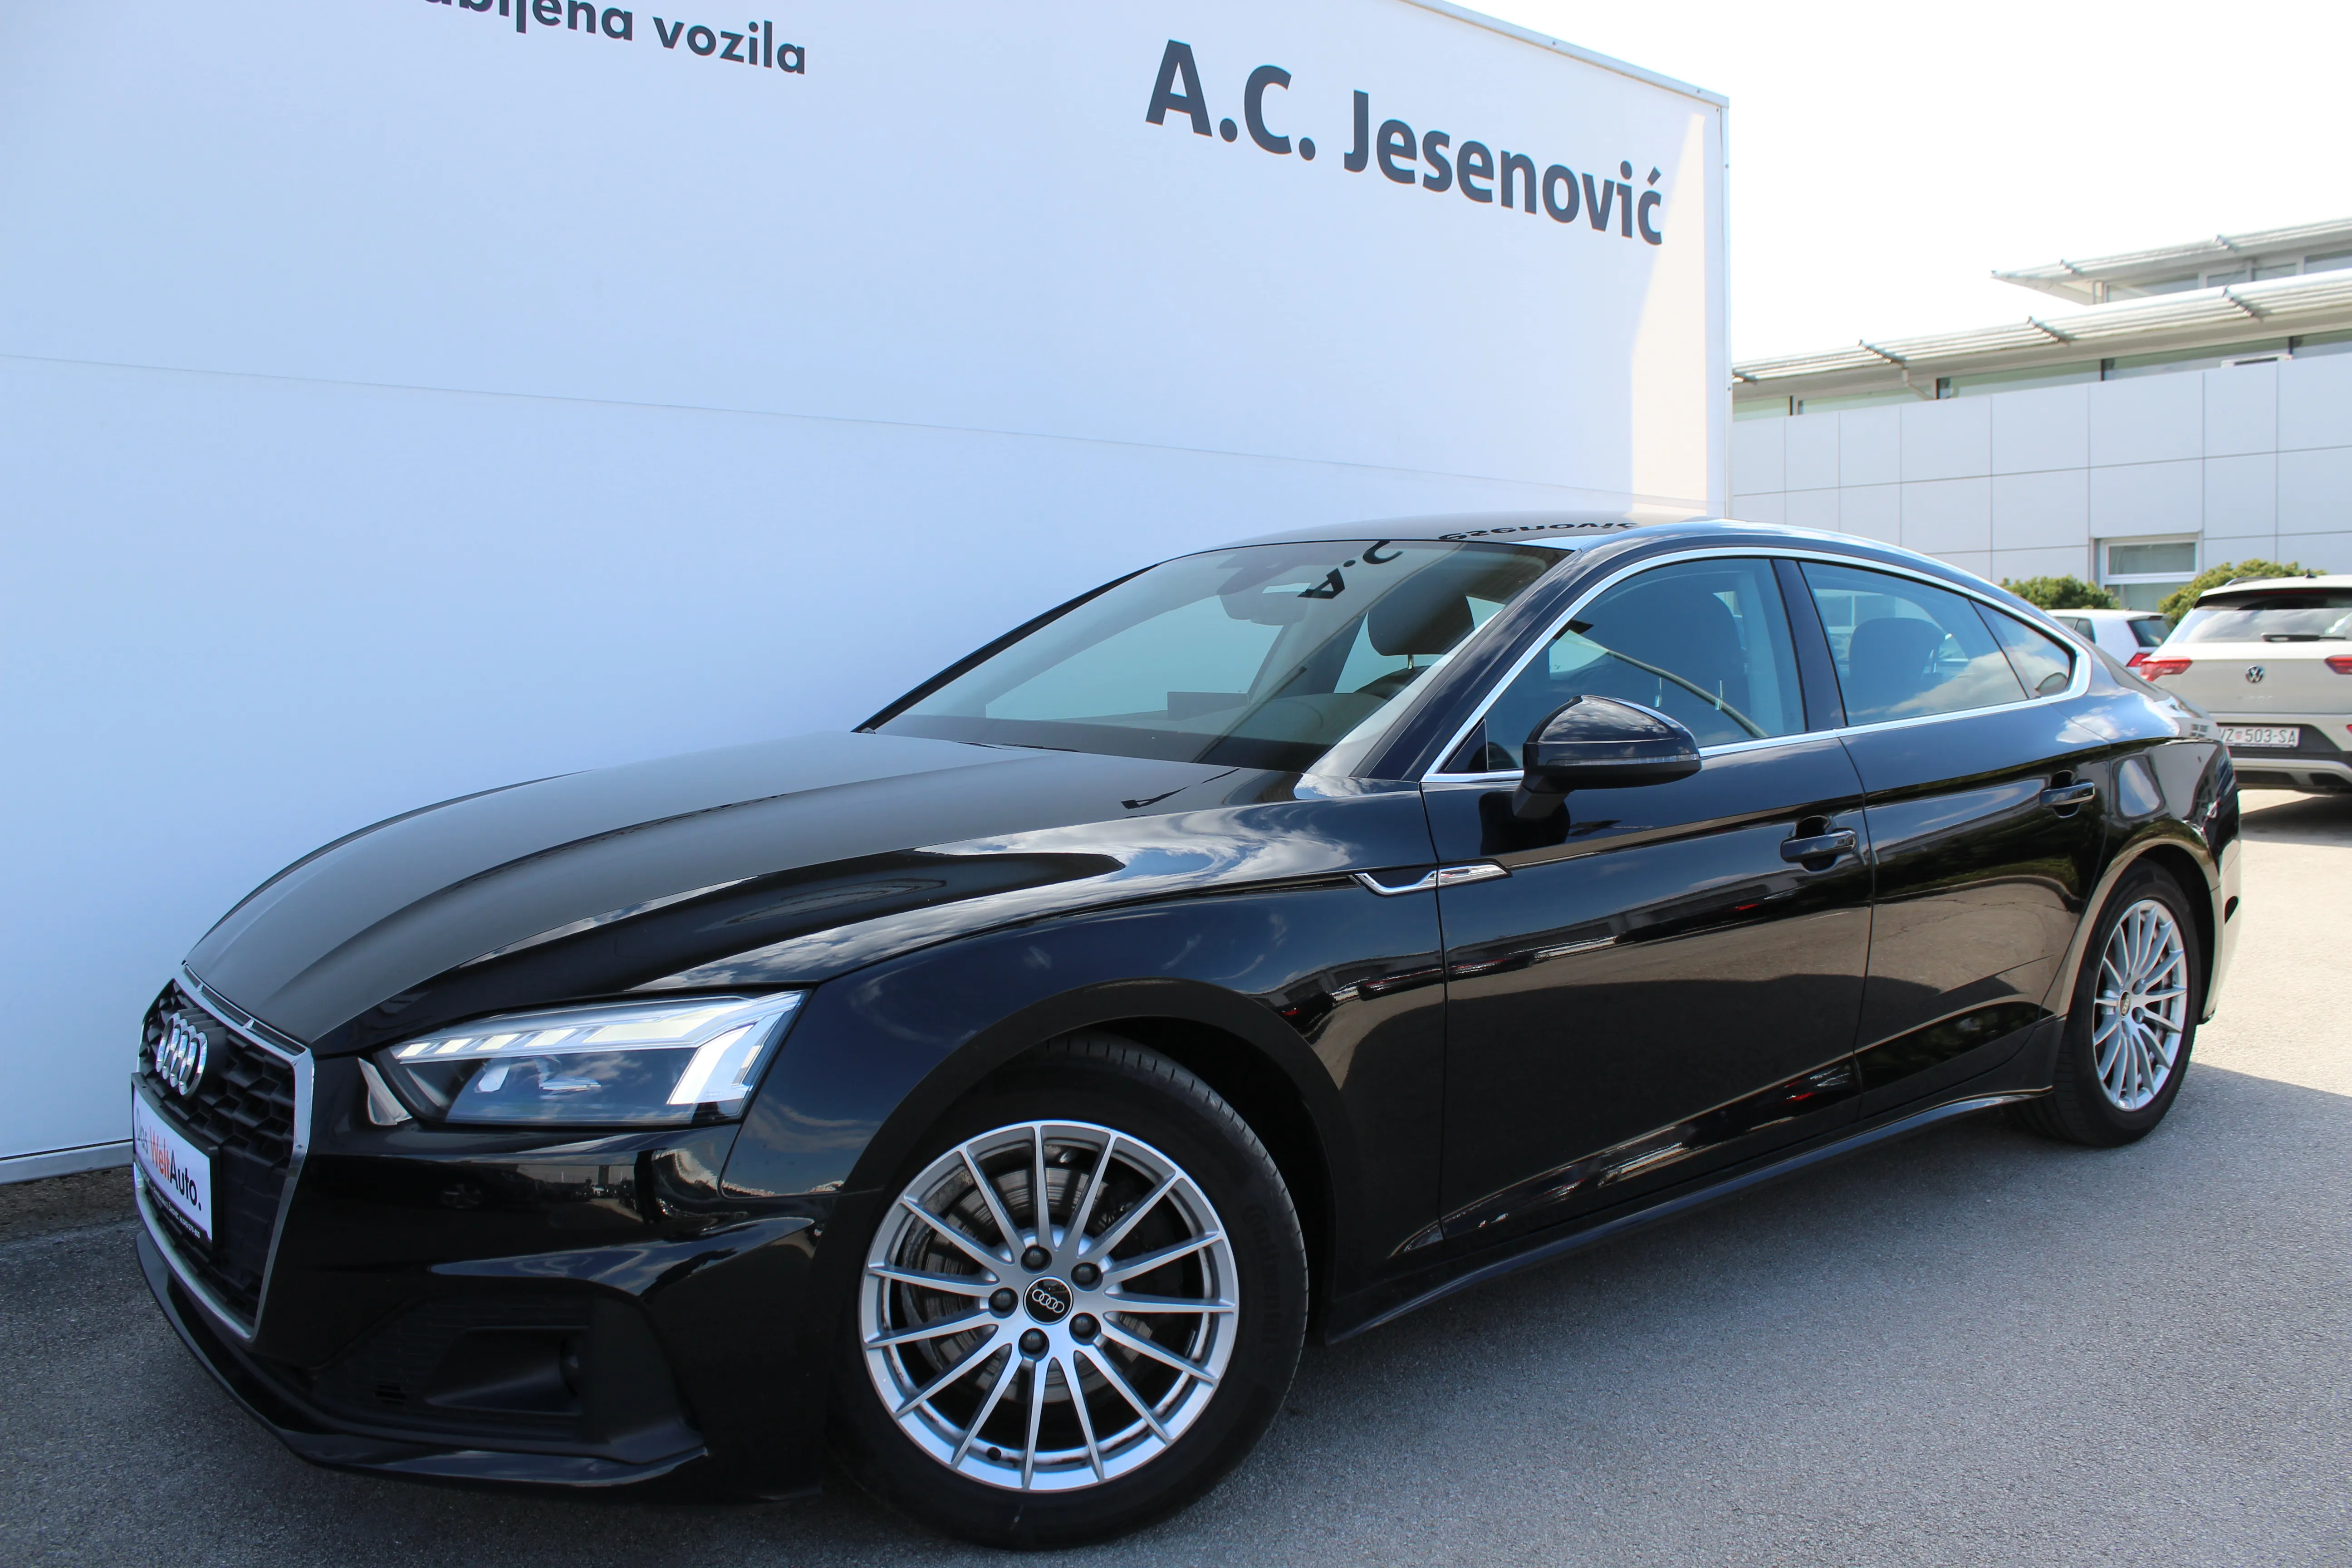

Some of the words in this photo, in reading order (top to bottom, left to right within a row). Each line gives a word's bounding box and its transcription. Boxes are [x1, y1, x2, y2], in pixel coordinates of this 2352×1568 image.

[652, 17, 805, 74] vozila
[1145, 39, 1316, 161] A.C.
[1343, 89, 1662, 245] Jesenović
[2245, 728, 2296, 743] 503-SA
[137, 1107, 149, 1155] Das
[149, 1125, 202, 1211] WeltAuto.
